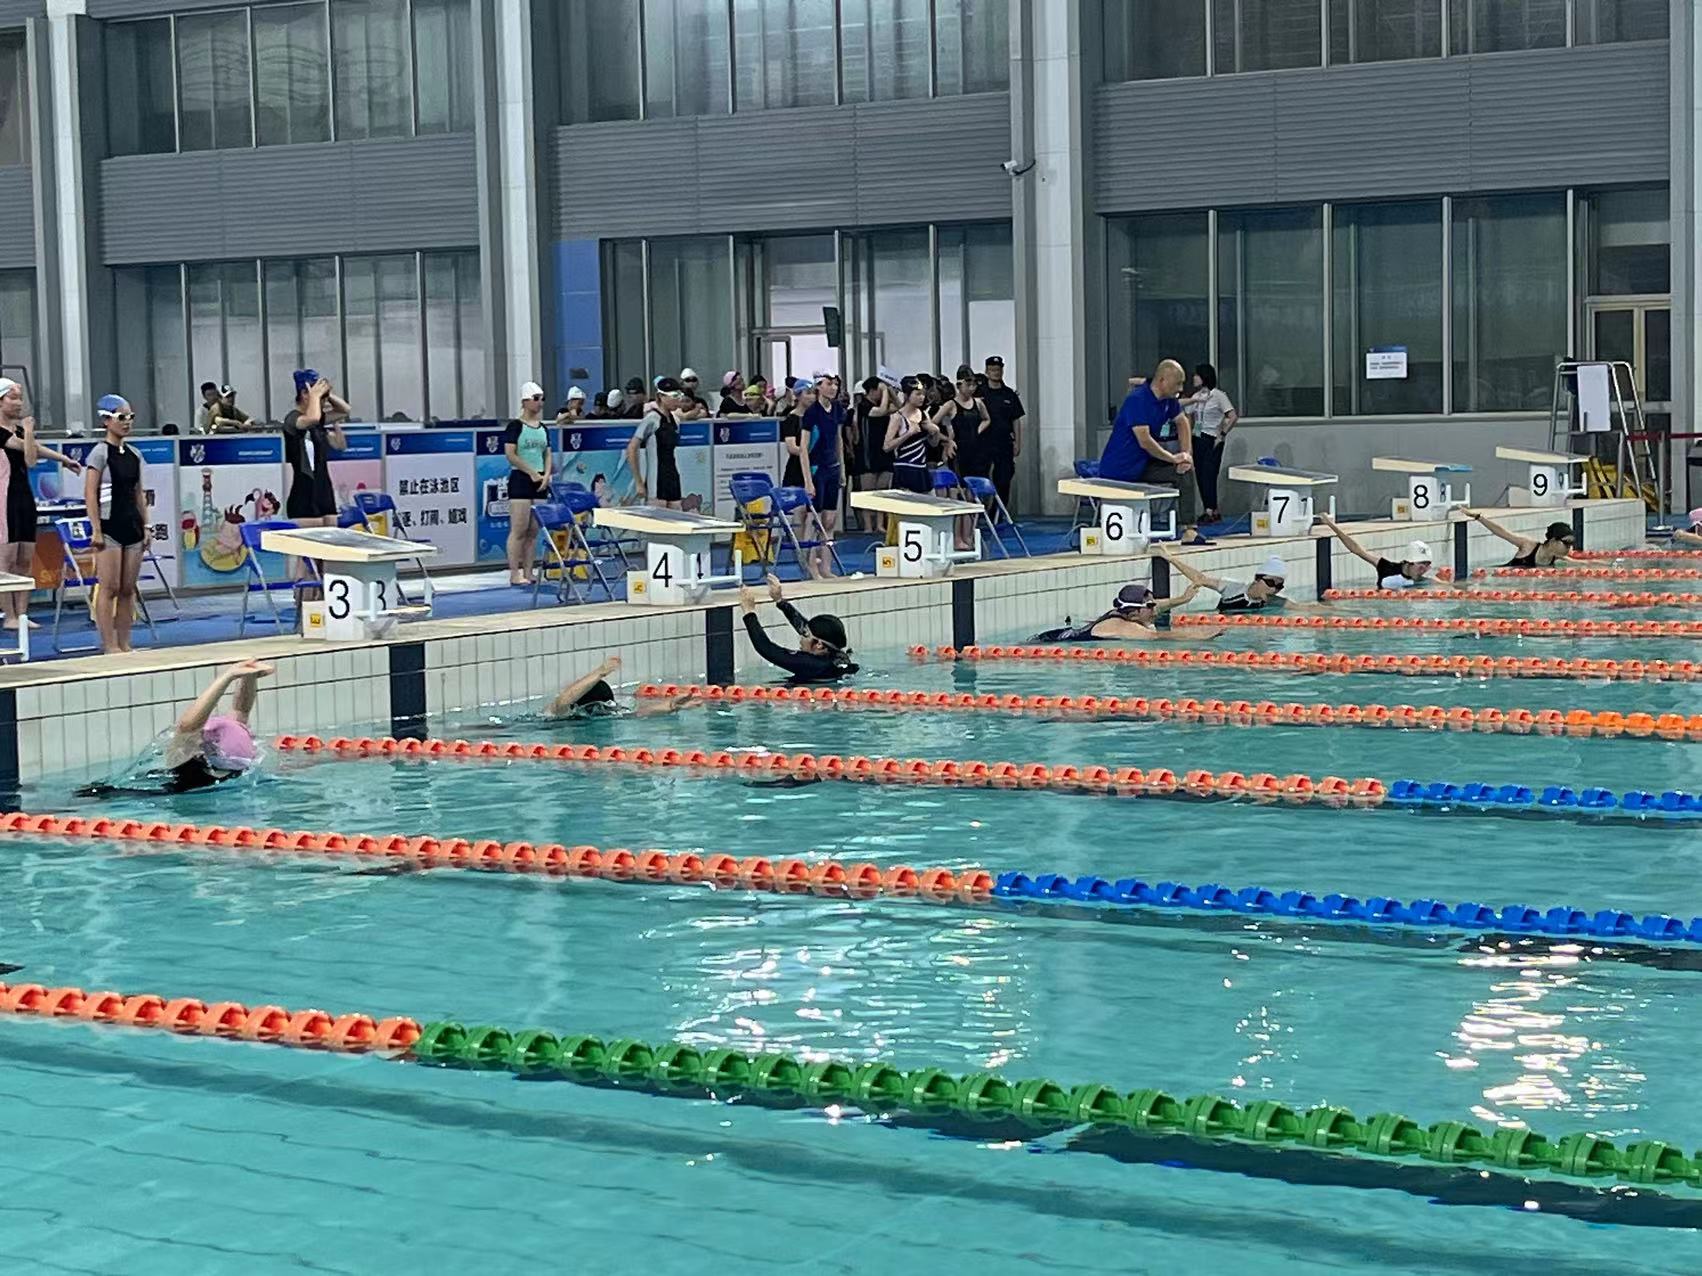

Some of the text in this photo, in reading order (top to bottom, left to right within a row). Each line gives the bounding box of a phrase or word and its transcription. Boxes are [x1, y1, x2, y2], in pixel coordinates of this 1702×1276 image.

[399, 477, 459, 496] 禁止在泳池区
[1414, 484, 1429, 509] 8
[1533, 474, 1548, 496] 9
[1272, 496, 1290, 524] 7
[1106, 512, 1123, 540] 6
[904, 530, 922, 562] 5
[652, 552, 673, 587] 4
[329, 579, 350, 620] 3
